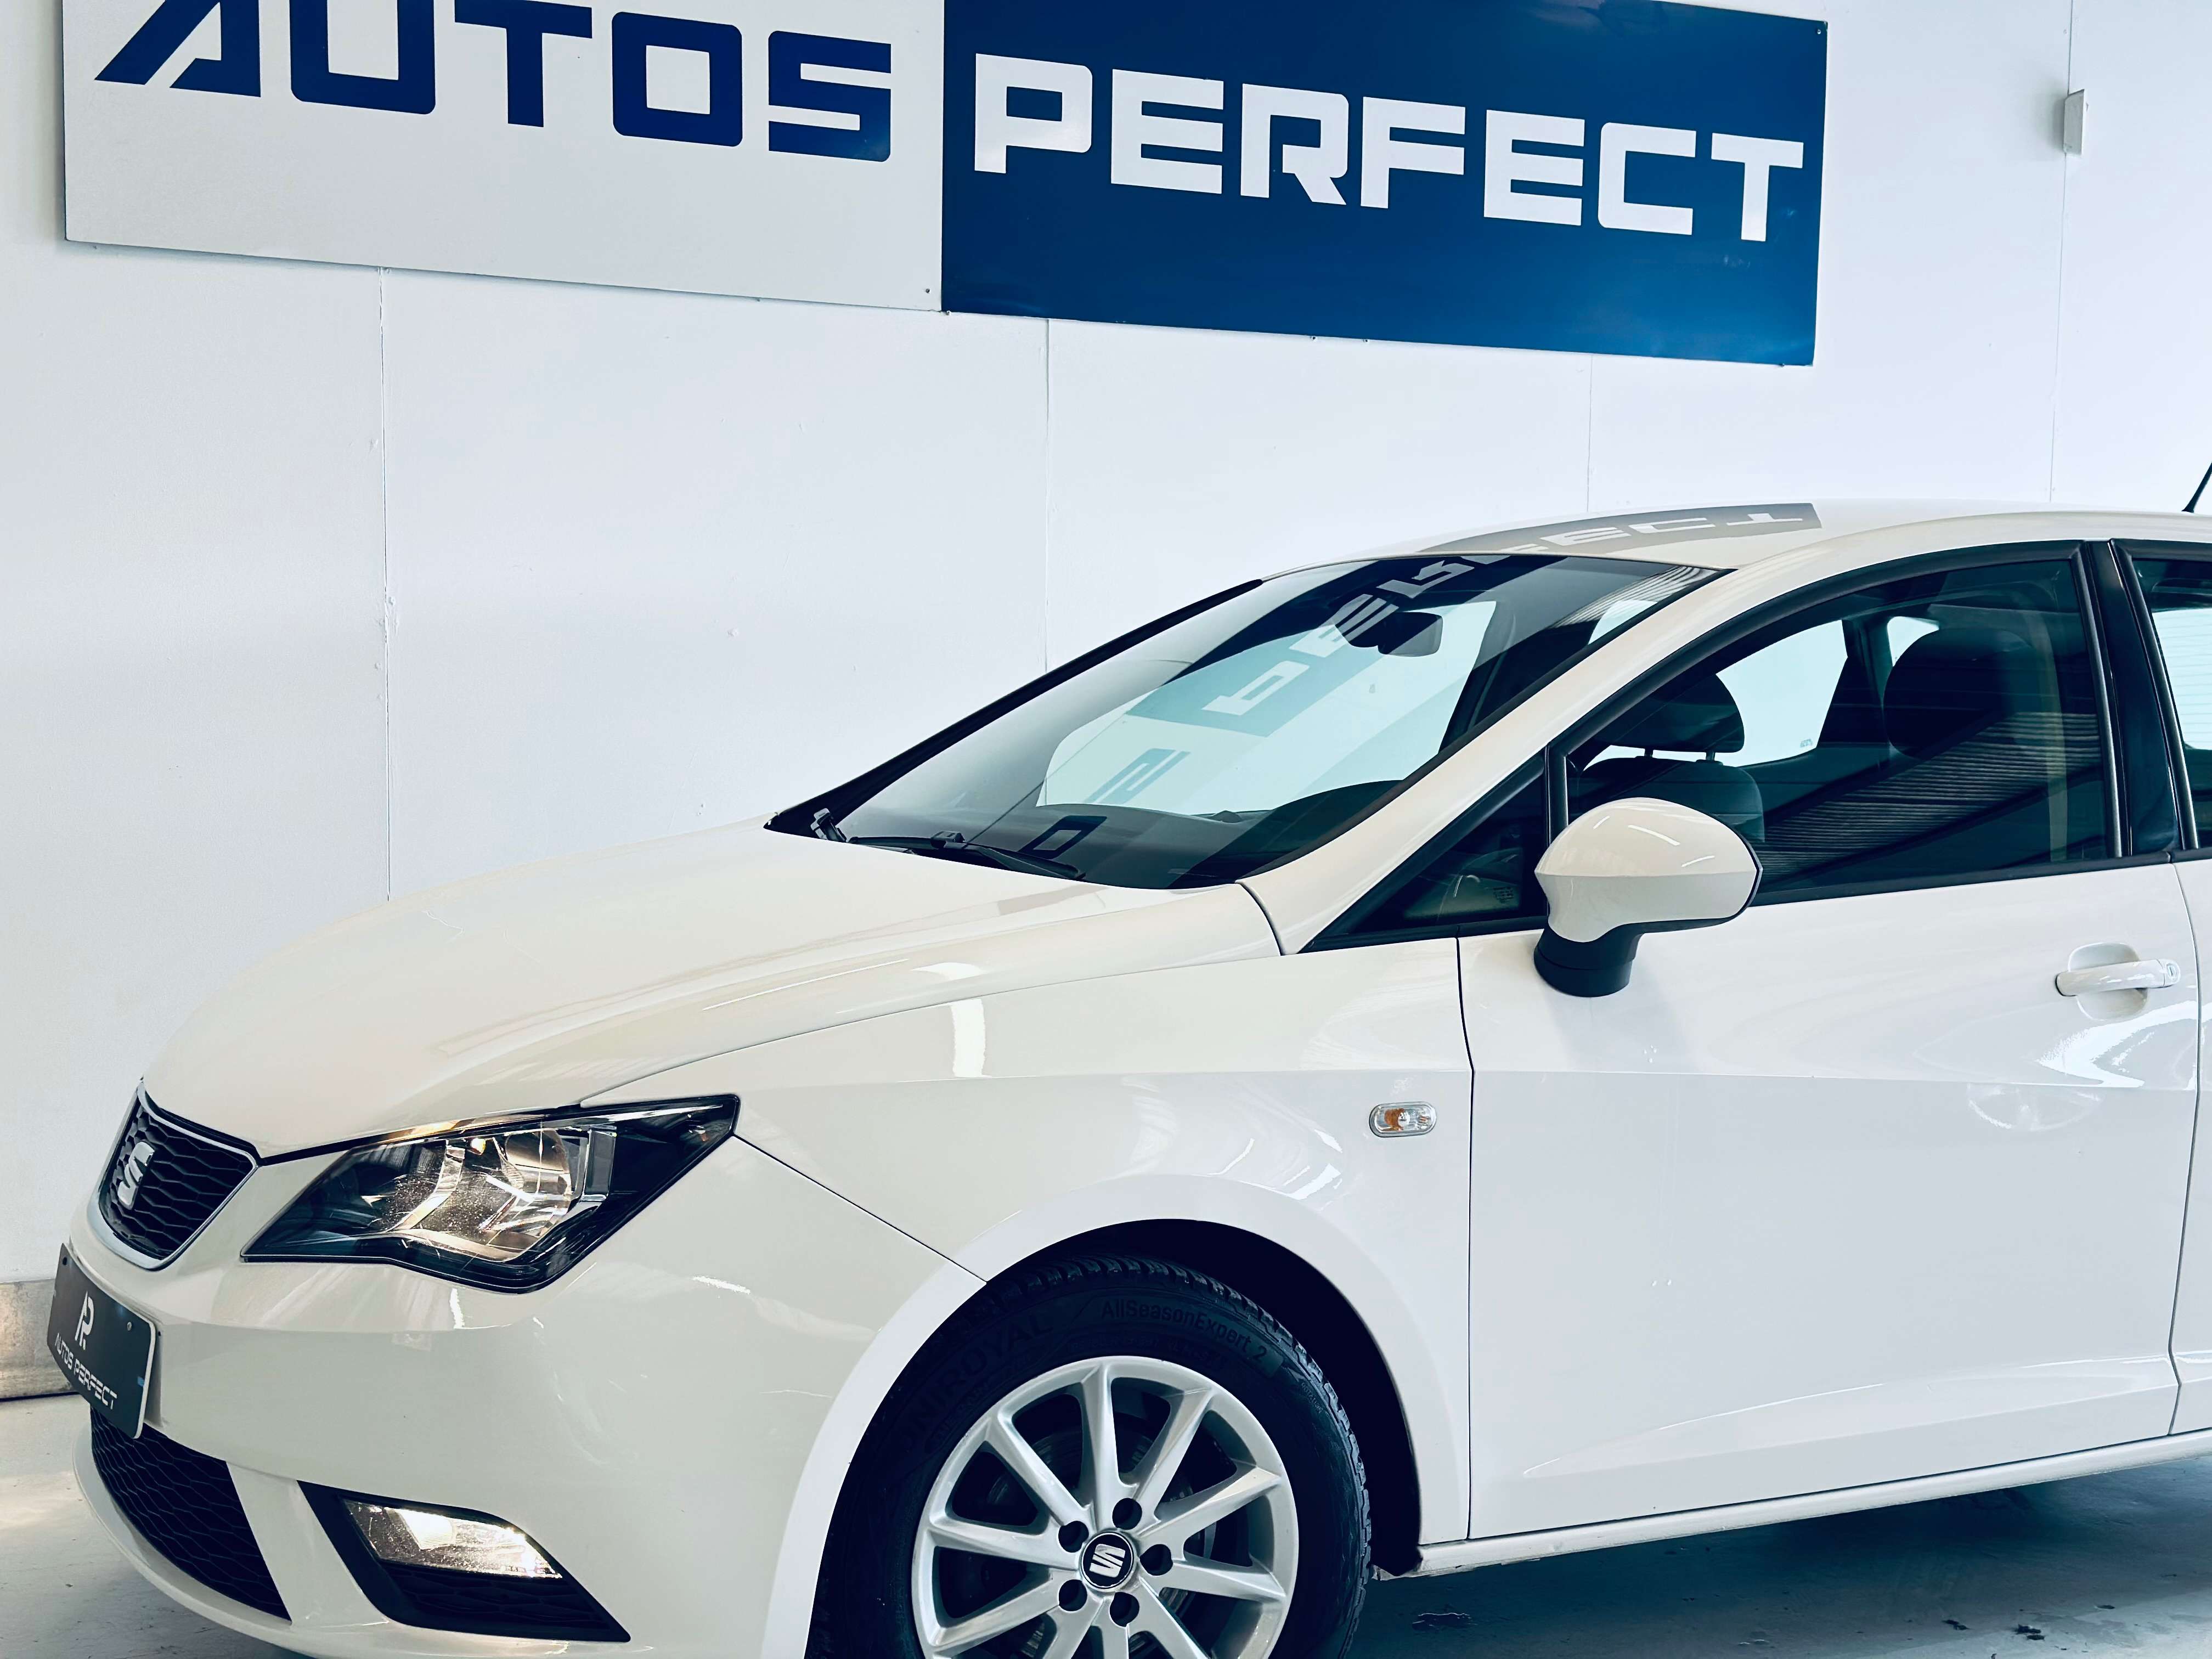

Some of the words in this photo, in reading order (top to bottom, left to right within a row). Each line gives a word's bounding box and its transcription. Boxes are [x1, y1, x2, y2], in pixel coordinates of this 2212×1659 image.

[94, 0, 891, 162] AUTOS
[975, 53, 1804, 242] PERFECT
[1101, 1299, 1252, 1351] AllSeasonExpert
[1258, 1345, 1268, 1363] 2
[55, 1333, 74, 1370] AUTOS
[74, 1358, 117, 1410] PERFECT
